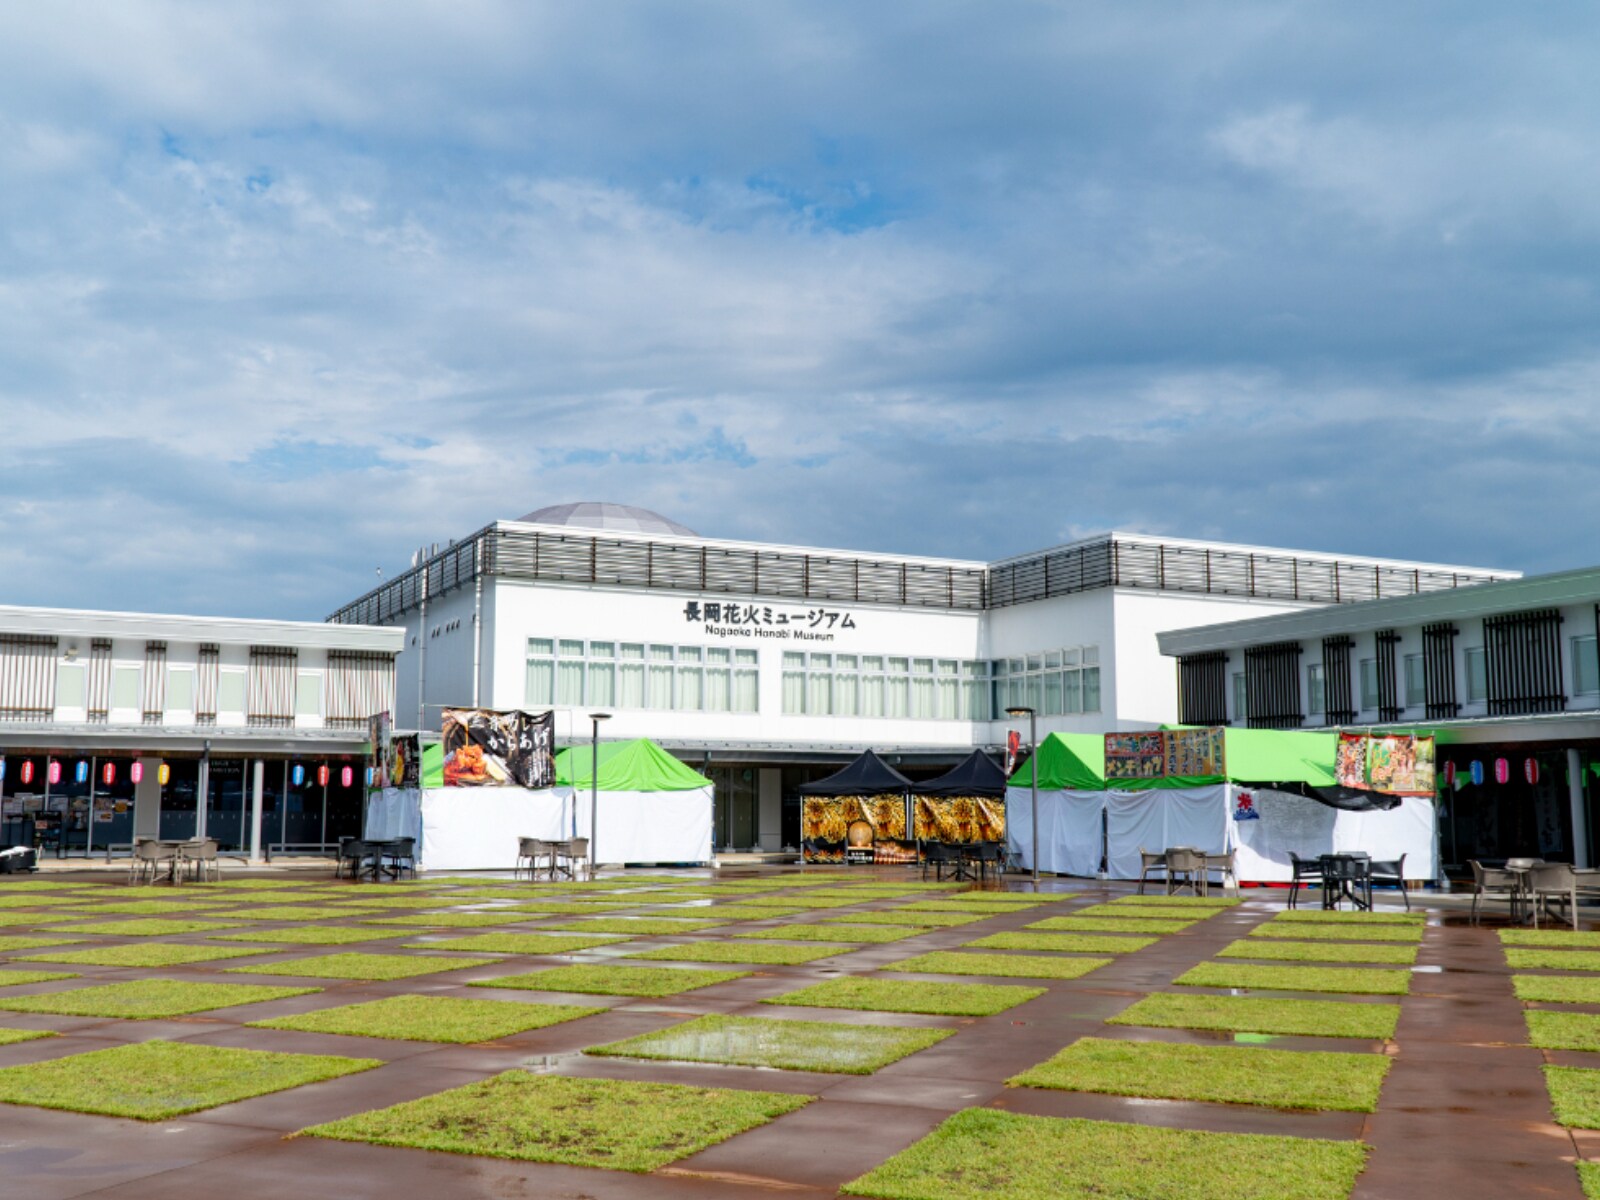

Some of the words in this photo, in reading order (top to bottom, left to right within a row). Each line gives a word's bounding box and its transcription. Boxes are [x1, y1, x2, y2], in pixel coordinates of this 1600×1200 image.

[684, 601, 856, 629] 長岡花火ミュージアム
[705, 624, 751, 638] Nagaoka
[754, 627, 791, 639] Hanabi
[794, 629, 834, 641] Museum
[488, 727, 550, 750] からあげ
